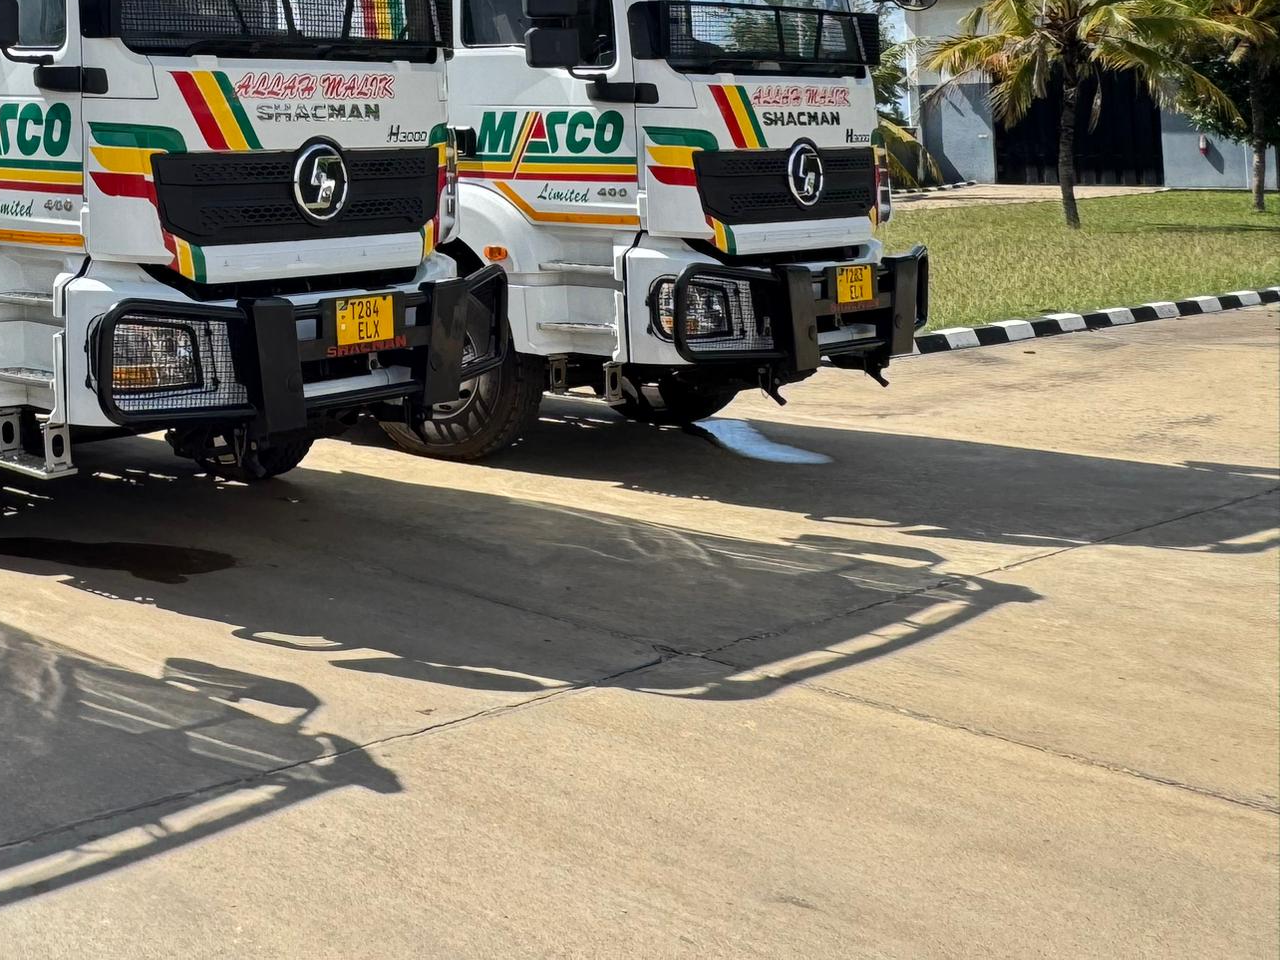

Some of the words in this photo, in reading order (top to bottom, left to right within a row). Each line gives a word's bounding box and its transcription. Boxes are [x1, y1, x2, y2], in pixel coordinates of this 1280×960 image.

[235, 72, 318, 100] ALLAH
[320, 73, 395, 100] MALIK
[256, 103, 380, 122] SHACMAN
[762, 112, 841, 126] SHACMAN
[387, 125, 428, 143] H3000
[477, 110, 625, 154] MASCO
[537, 183, 590, 202] Limited
[350, 300, 379, 320] T284
[358, 320, 380, 340] ELX
